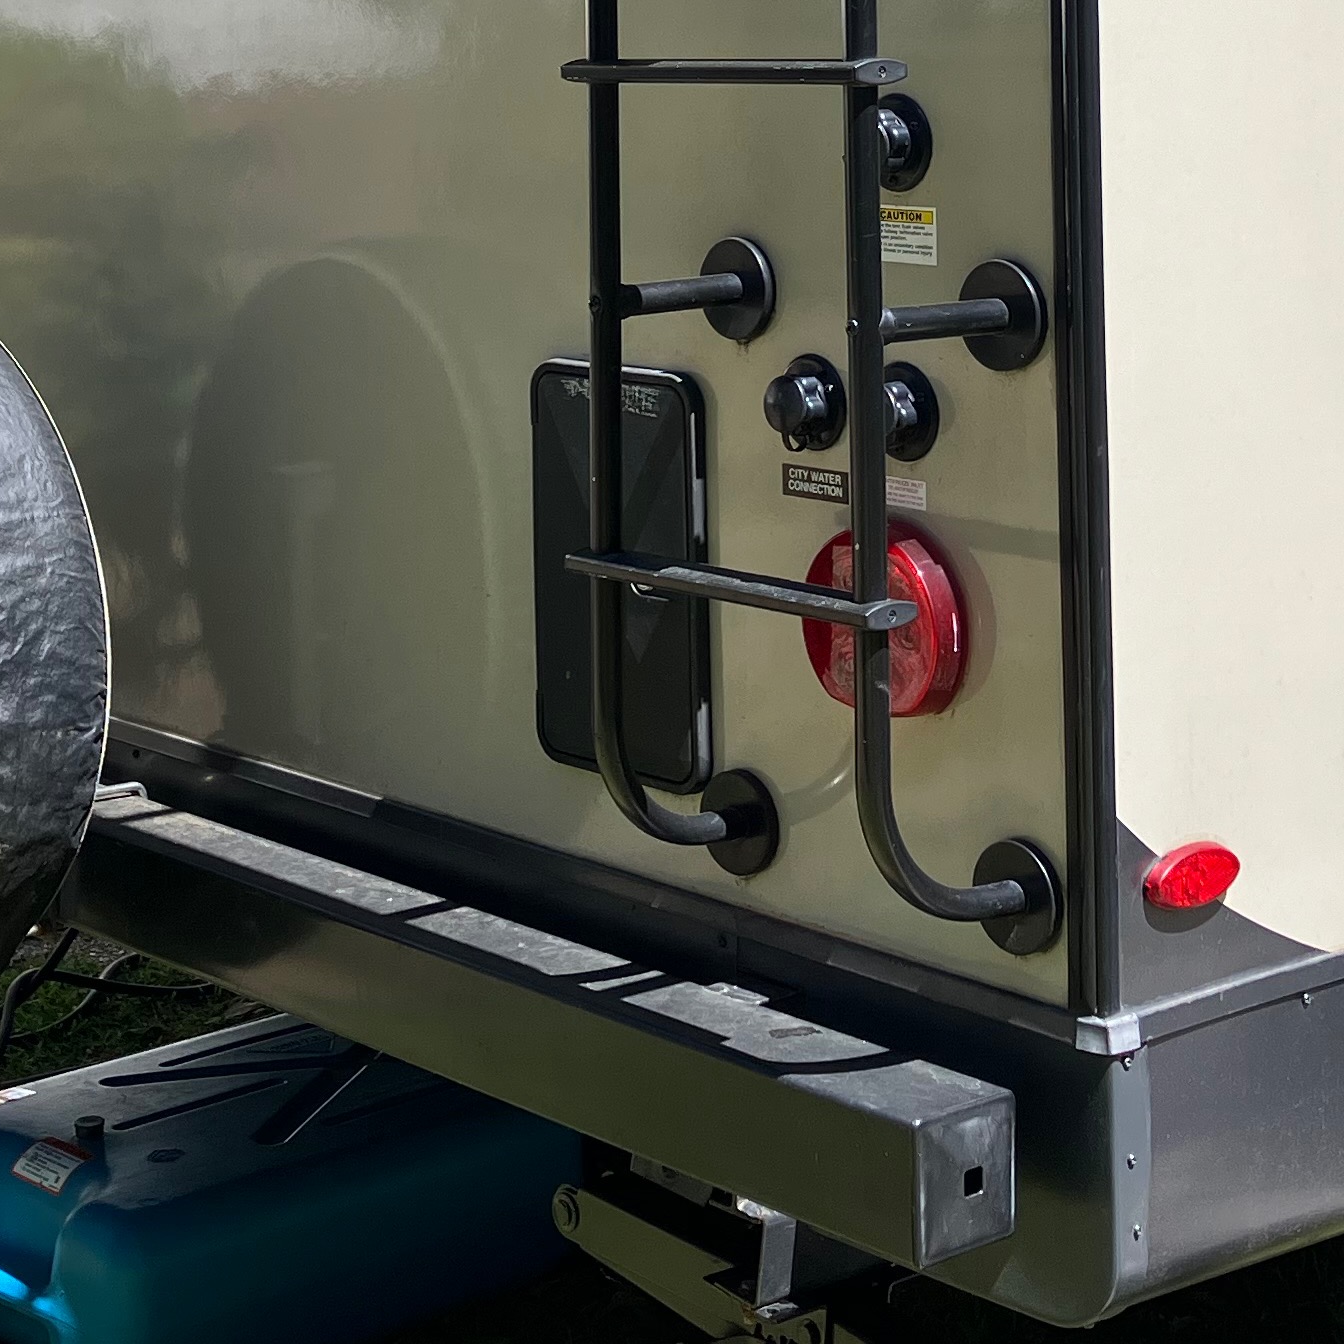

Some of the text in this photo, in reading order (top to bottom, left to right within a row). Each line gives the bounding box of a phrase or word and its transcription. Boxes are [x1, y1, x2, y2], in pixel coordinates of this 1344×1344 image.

[880, 210, 922, 222] CAUTION
[788, 468, 842, 485] CITY WATER
[788, 480, 843, 497] CONNECTION
